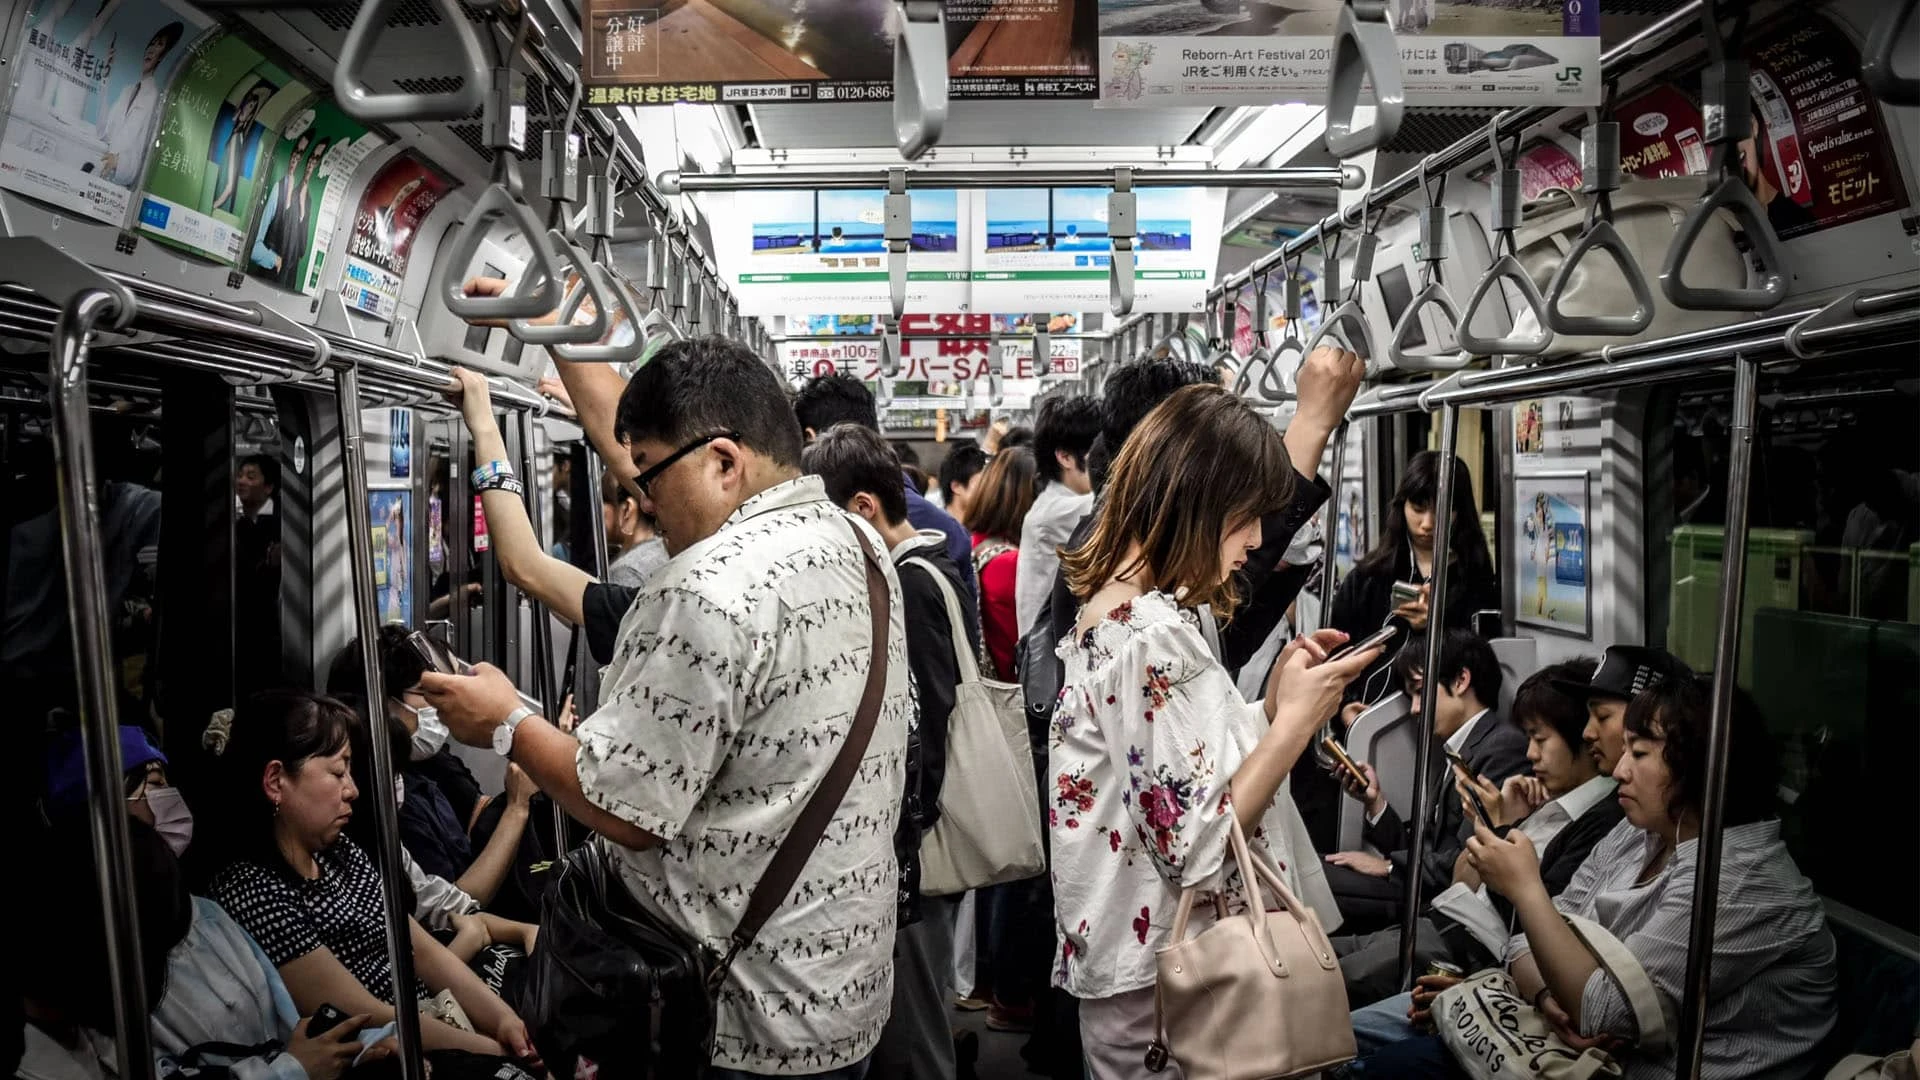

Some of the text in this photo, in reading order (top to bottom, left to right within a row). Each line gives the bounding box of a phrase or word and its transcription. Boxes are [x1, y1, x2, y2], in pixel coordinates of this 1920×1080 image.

[627, 16, 646, 52] 好評
[1182, 49, 1252, 60] Reborn-Art
[1258, 49, 1305, 60] Festival
[1182, 66, 1299, 78] JRをご利用ください。
[1555, 67, 1582, 82] JR
[588, 84, 717, 104] 温泉付き住宅地
[726, 87, 787, 97] JR東日本の街
[1063, 83, 1097, 92] アーベスト
[1807, 135, 1828, 159] Speed
[1827, 171, 1881, 205] モビット
[1450, 995, 1505, 1074] PRODUCTS
